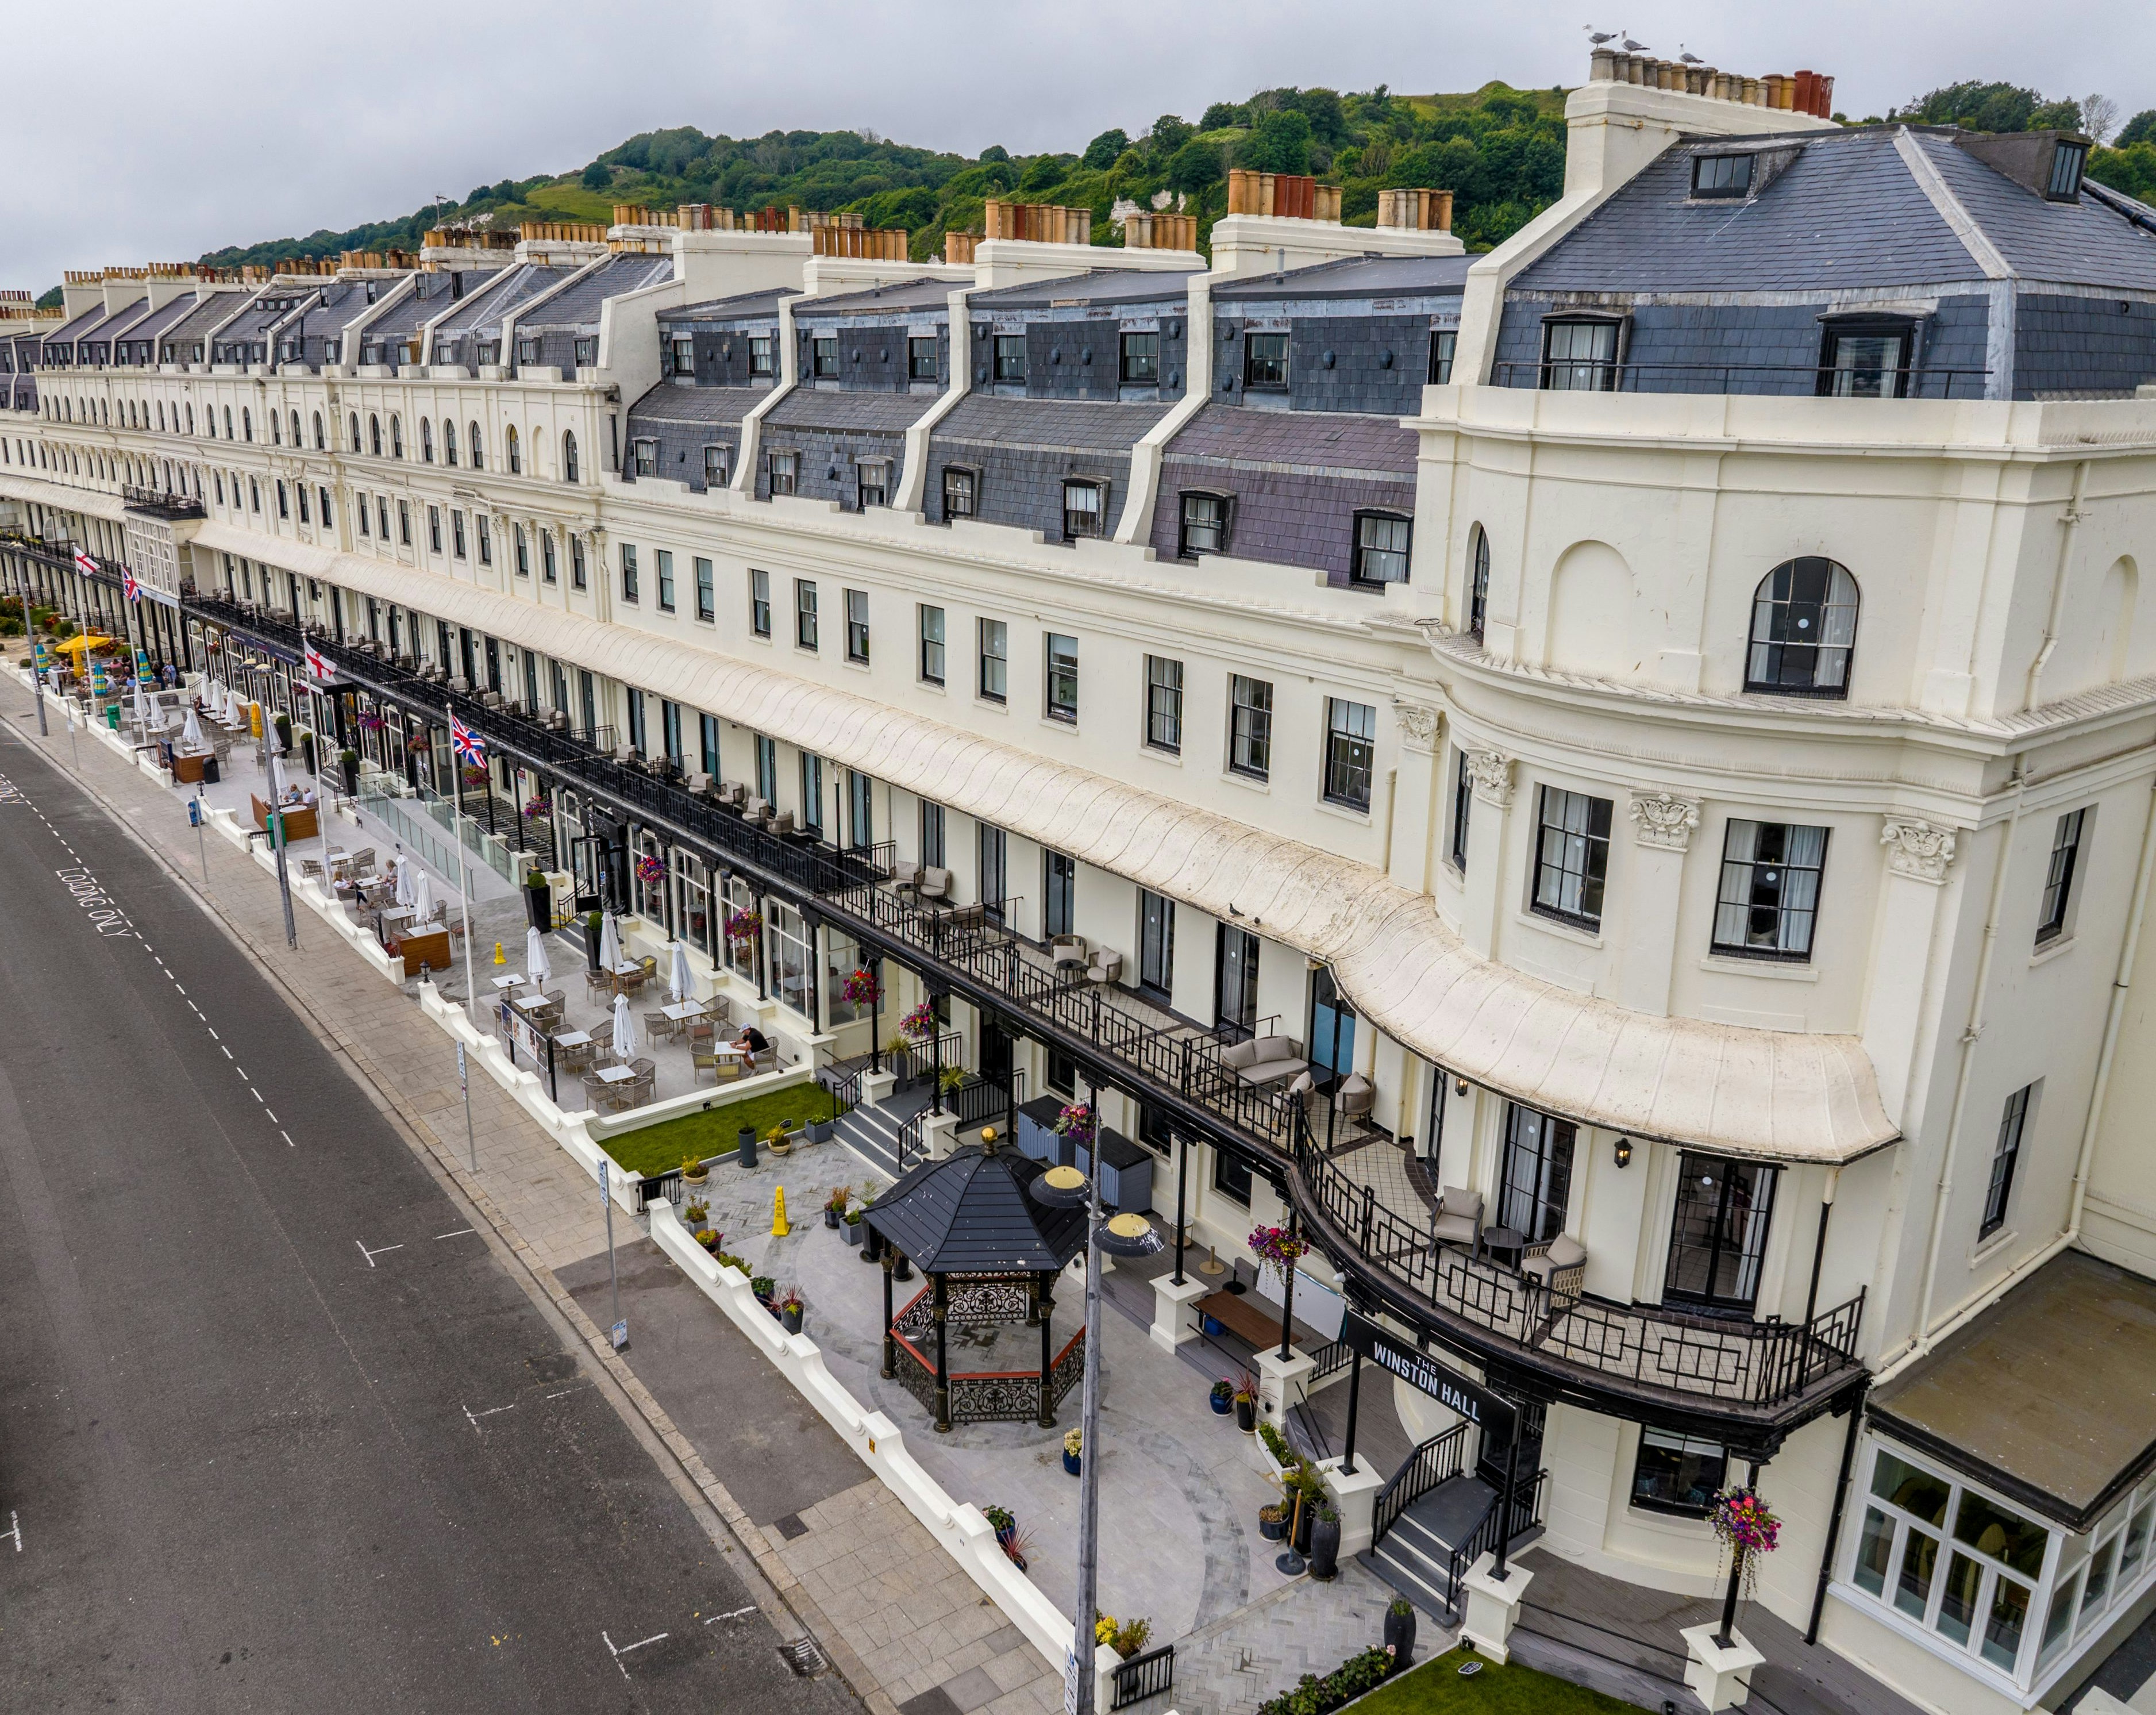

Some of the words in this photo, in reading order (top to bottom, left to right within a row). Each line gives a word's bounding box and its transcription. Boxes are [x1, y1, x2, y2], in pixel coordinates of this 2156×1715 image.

[56, 868, 106, 907] LOADING
[88, 910, 132, 937] ONLY
[1374, 1341, 1438, 1395] WINSTON
[1441, 1383, 1480, 1422] HALL
[1415, 1355, 1436, 1375] THE
